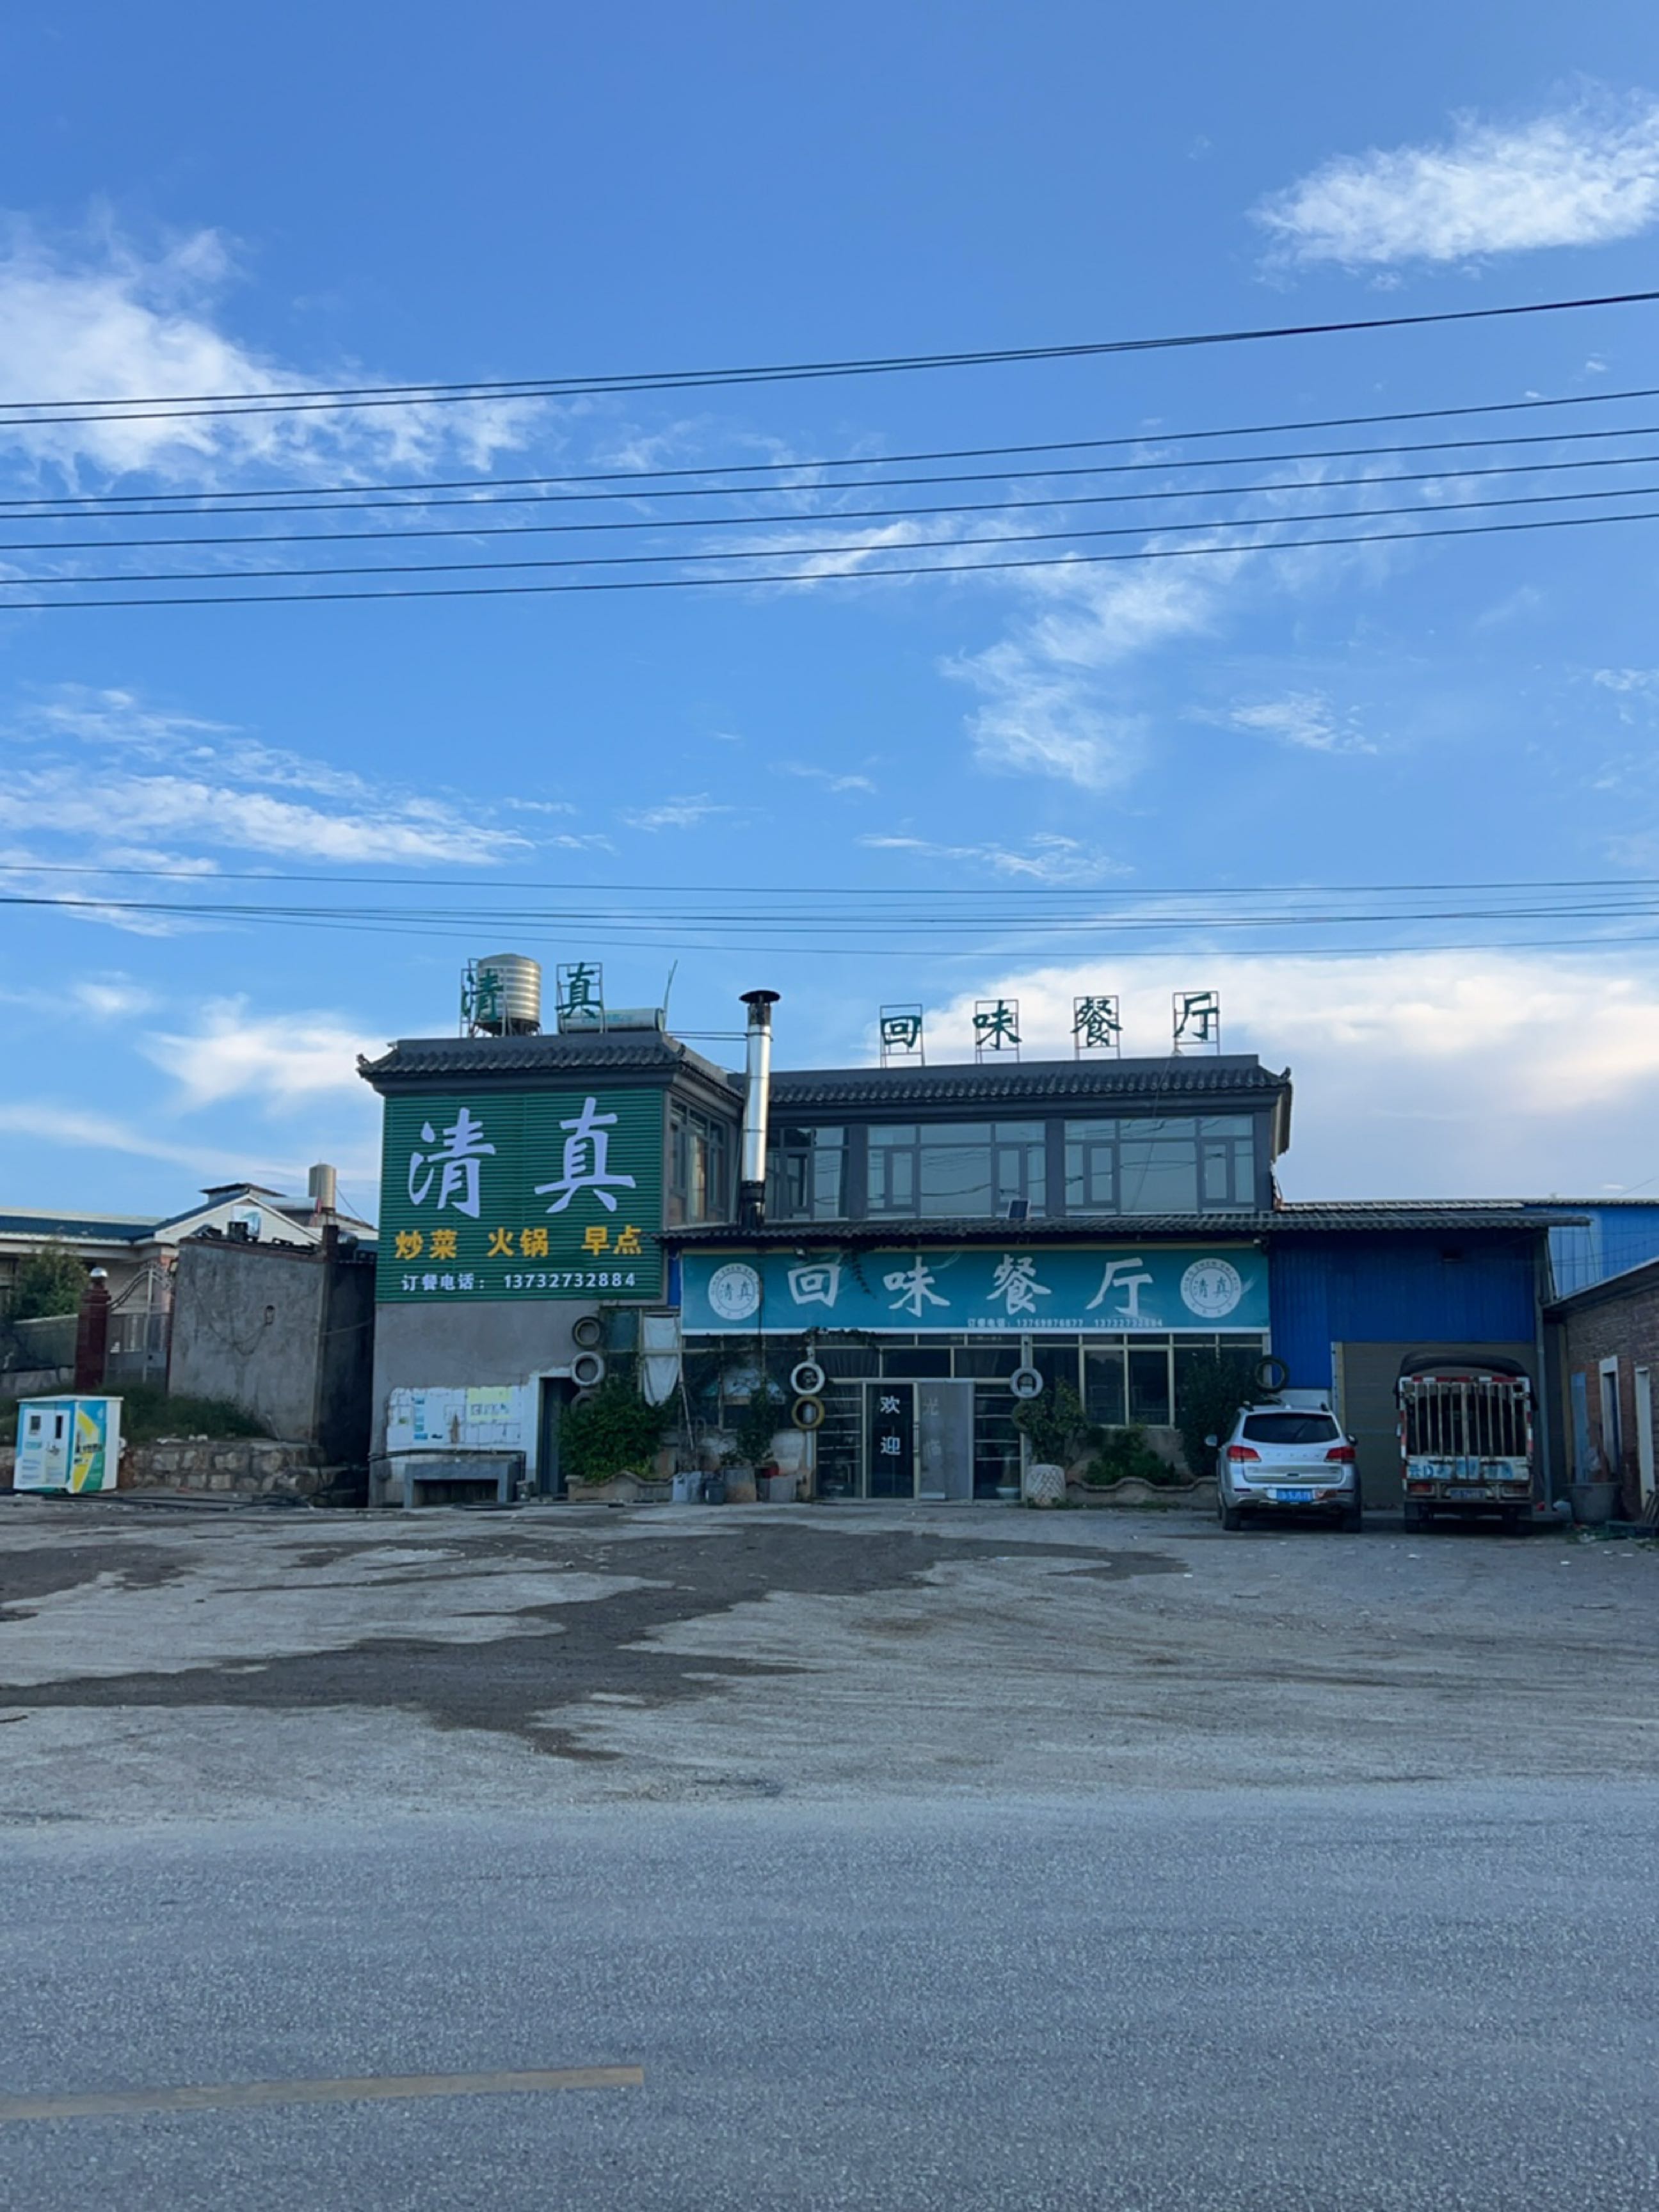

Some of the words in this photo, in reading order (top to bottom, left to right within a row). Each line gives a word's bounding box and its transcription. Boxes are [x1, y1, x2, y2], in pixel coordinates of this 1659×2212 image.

[461, 962, 602, 1022] 清真
[880, 992, 1219, 1051] 回味餐厅
[408, 1096, 636, 1219] 清真
[394, 1229, 458, 1260] 炒菜
[487, 1227, 549, 1257] 火锅
[581, 1225, 643, 1255] 早点
[504, 1272, 636, 1289] 13732732884
[787, 1253, 1153, 1318] 回味餐厅
[1193, 1276, 1230, 1299] 清真
[879, 1395, 902, 1455] 欢迎
